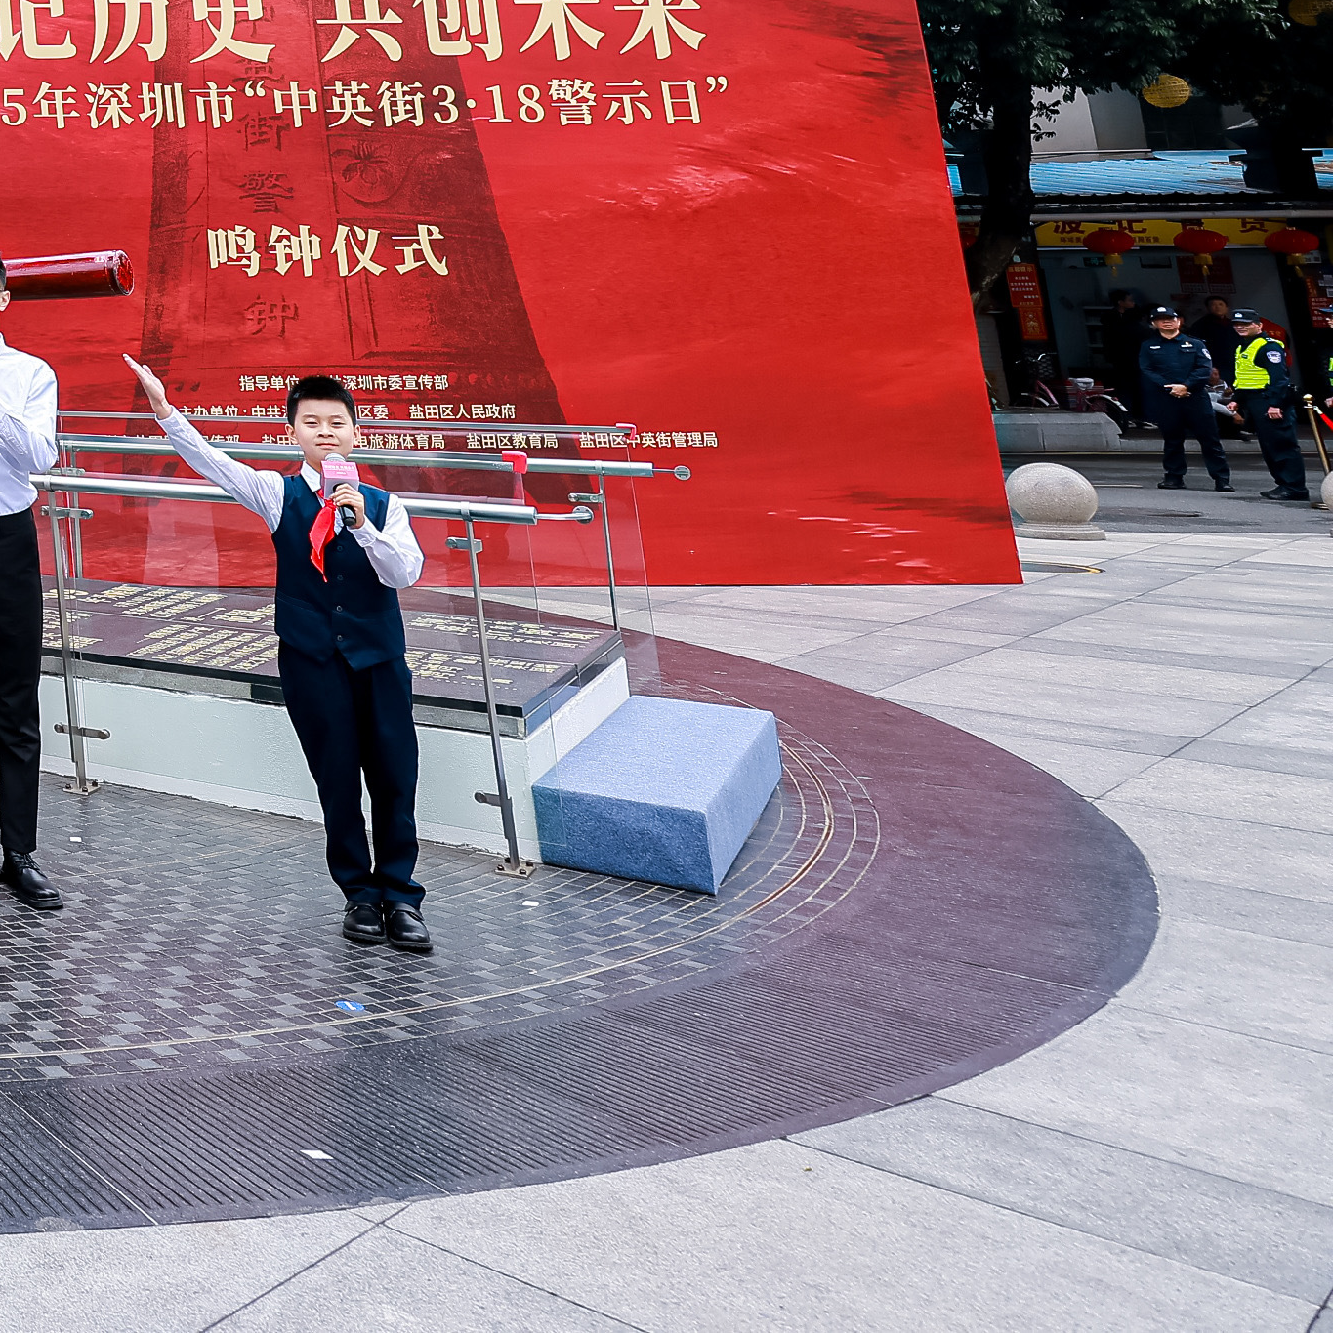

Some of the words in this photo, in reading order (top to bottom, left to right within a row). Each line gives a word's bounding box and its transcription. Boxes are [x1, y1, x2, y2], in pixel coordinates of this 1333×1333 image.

[206, 223, 450, 278] 鸣钟仪式
[408, 403, 517, 420] 盐田区人民政府
[465, 432, 559, 449] 盐田区教育局
[579, 430, 719, 449] 盐田区中英街管理局
